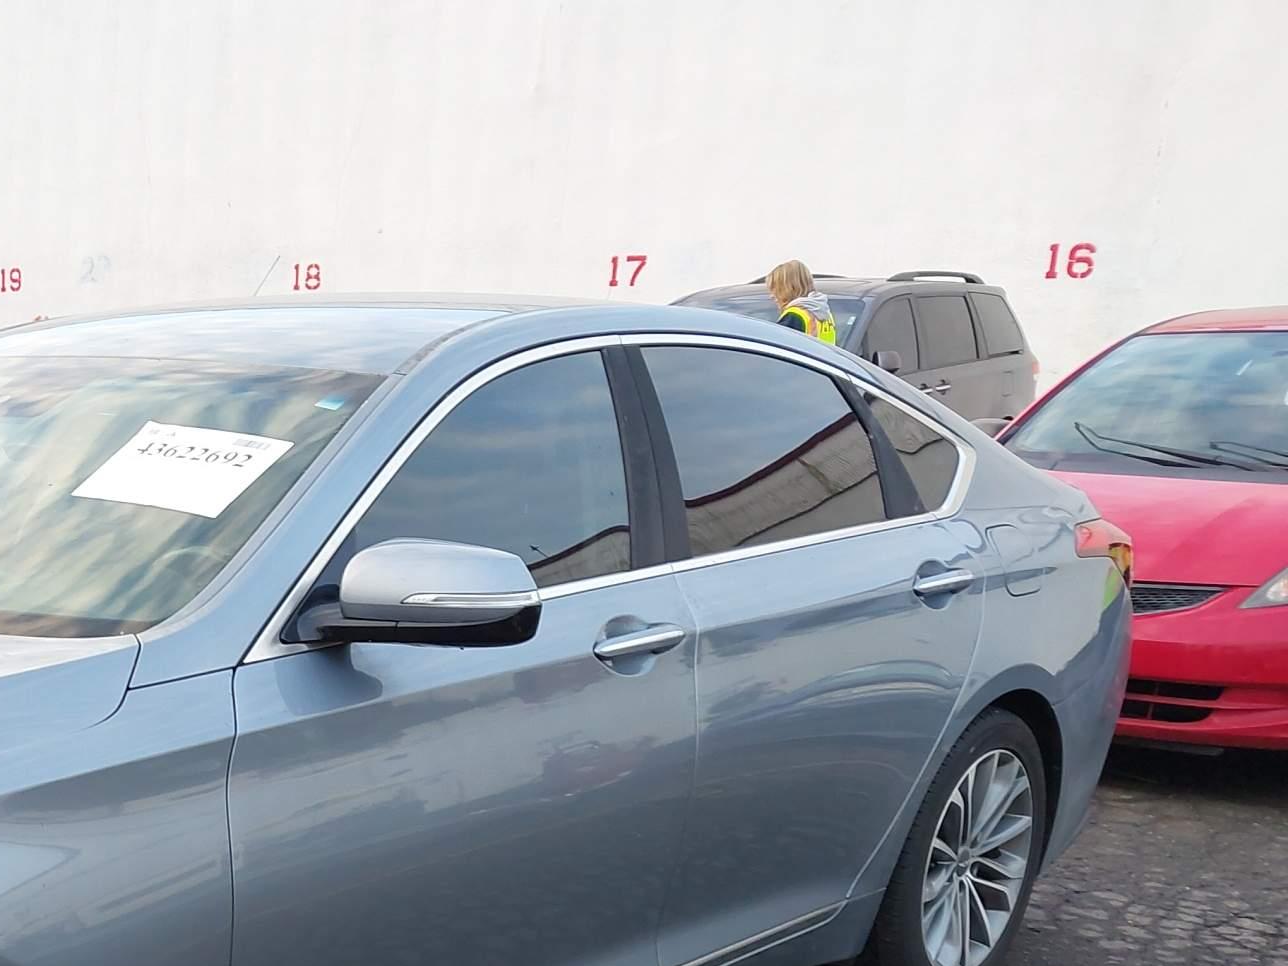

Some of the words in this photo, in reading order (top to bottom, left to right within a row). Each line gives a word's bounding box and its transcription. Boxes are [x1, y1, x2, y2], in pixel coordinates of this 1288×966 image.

[608, 255, 649, 288] 17
[1044, 242, 1097, 281] 16
[0, 267, 22, 293] 19
[292, 263, 322, 291] 18
[137, 442, 253, 468] 43622692
